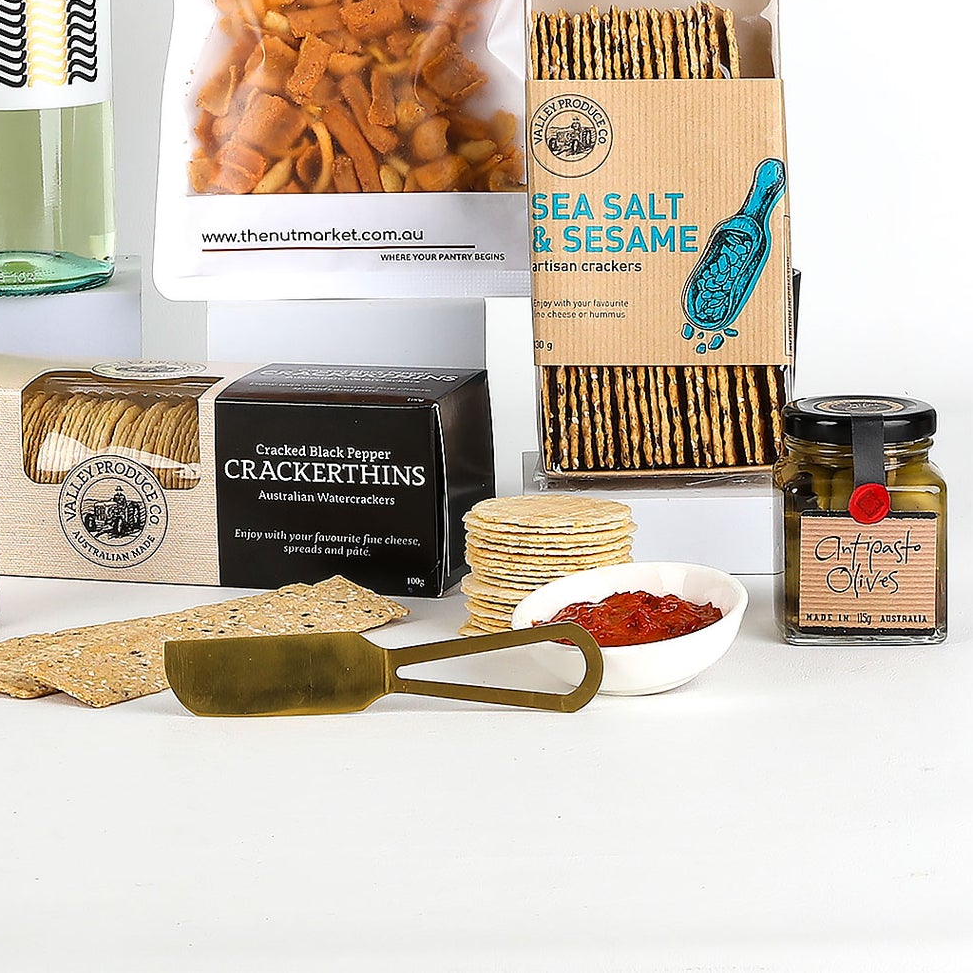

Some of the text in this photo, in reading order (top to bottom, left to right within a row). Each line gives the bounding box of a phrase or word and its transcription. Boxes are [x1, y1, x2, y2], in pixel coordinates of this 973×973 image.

[534, 102, 557, 145] VALLEY
[558, 98, 606, 127] PRODUCE
[531, 192, 684, 220] SEA SALT
[201, 228, 424, 243] www.thenutmarket.com.au
[532, 225, 699, 253] & SESAME
[380, 253, 505, 261] WHERE YOUR PANTRY BEGINS
[532, 259, 642, 273] artisan crackers
[533, 298, 629, 309] Enjoy with your favourite
[547, 310, 577, 319] cheese
[578, 311, 587, 319] or
[589, 310, 626, 319] hummus
[546, 342, 553, 352] g
[255, 443, 392, 463] Cracked Black Pepper
[224, 459, 426, 487] CRACKERTHINS
[64, 464, 95, 523] VALLEY
[95, 460, 159, 502] PRODUCE
[258, 489, 395, 506] Australian Watercrackers
[72, 530, 156, 561] AUSTRALIAN MADE
[234, 528, 421, 547] Enjoy with your favourite fine cheese,
[283, 544, 371, 557] spreads and pâté.
[406, 577, 425, 587] 100g
[826, 563, 900, 599] Olives
[806, 612, 928, 626] MADE IN 115g AUSTRALIA
